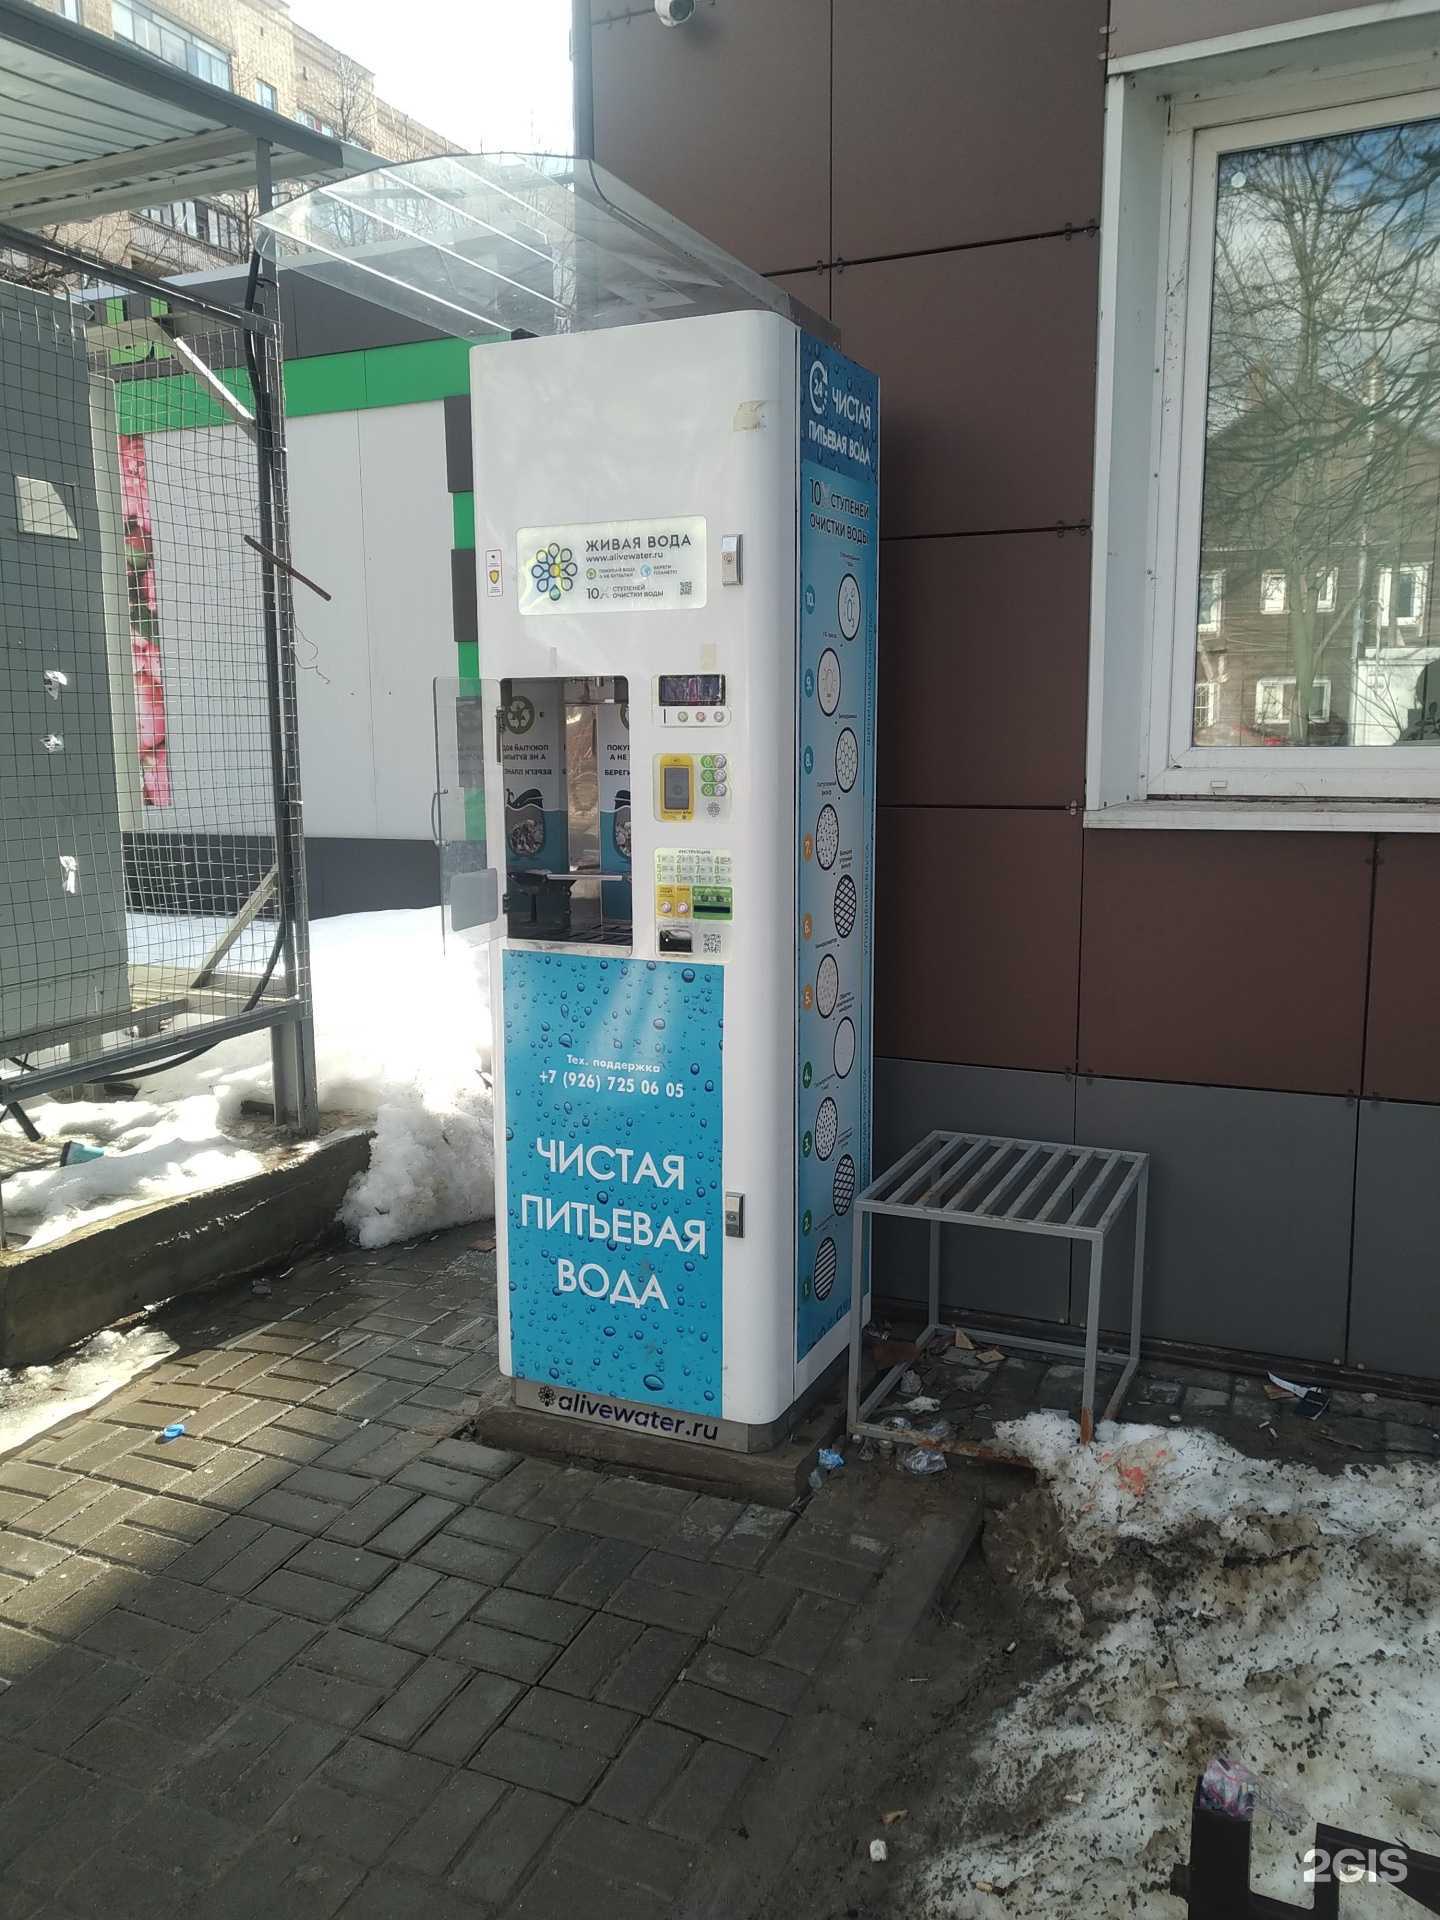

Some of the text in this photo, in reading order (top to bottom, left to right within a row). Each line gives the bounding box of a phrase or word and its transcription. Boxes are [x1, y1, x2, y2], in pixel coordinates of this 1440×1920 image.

[813, 379, 823, 398] 24
[831, 387, 871, 431] ЧИСТАЯ
[808, 419, 871, 466] ПИТЬЕВАЯ ВОДА
[809, 478, 821, 506] 10
[586, 534, 692, 552] ЖИВАЯ ВОДА
[810, 513, 869, 544] ОЧИСТКИ ВОДЫ
[586, 552, 664, 562] www.alivewater.ru
[586, 587, 600, 599] 10
[612, 584, 646, 592] СТУПЕНЕЙ
[612, 591, 642, 599] ОЧИСТКИ
[567, 1053, 661, 1074] Тех. поддержка
[539, 1069, 684, 1099] +7 (926) 725 06 05
[536, 1137, 685, 1191] ЧИСТАЯ
[521, 1193, 706, 1256] ПИТЬЕВАЯ
[557, 1257, 669, 1310] ВОДА
[558, 1393, 719, 1441] alivewater.ru
